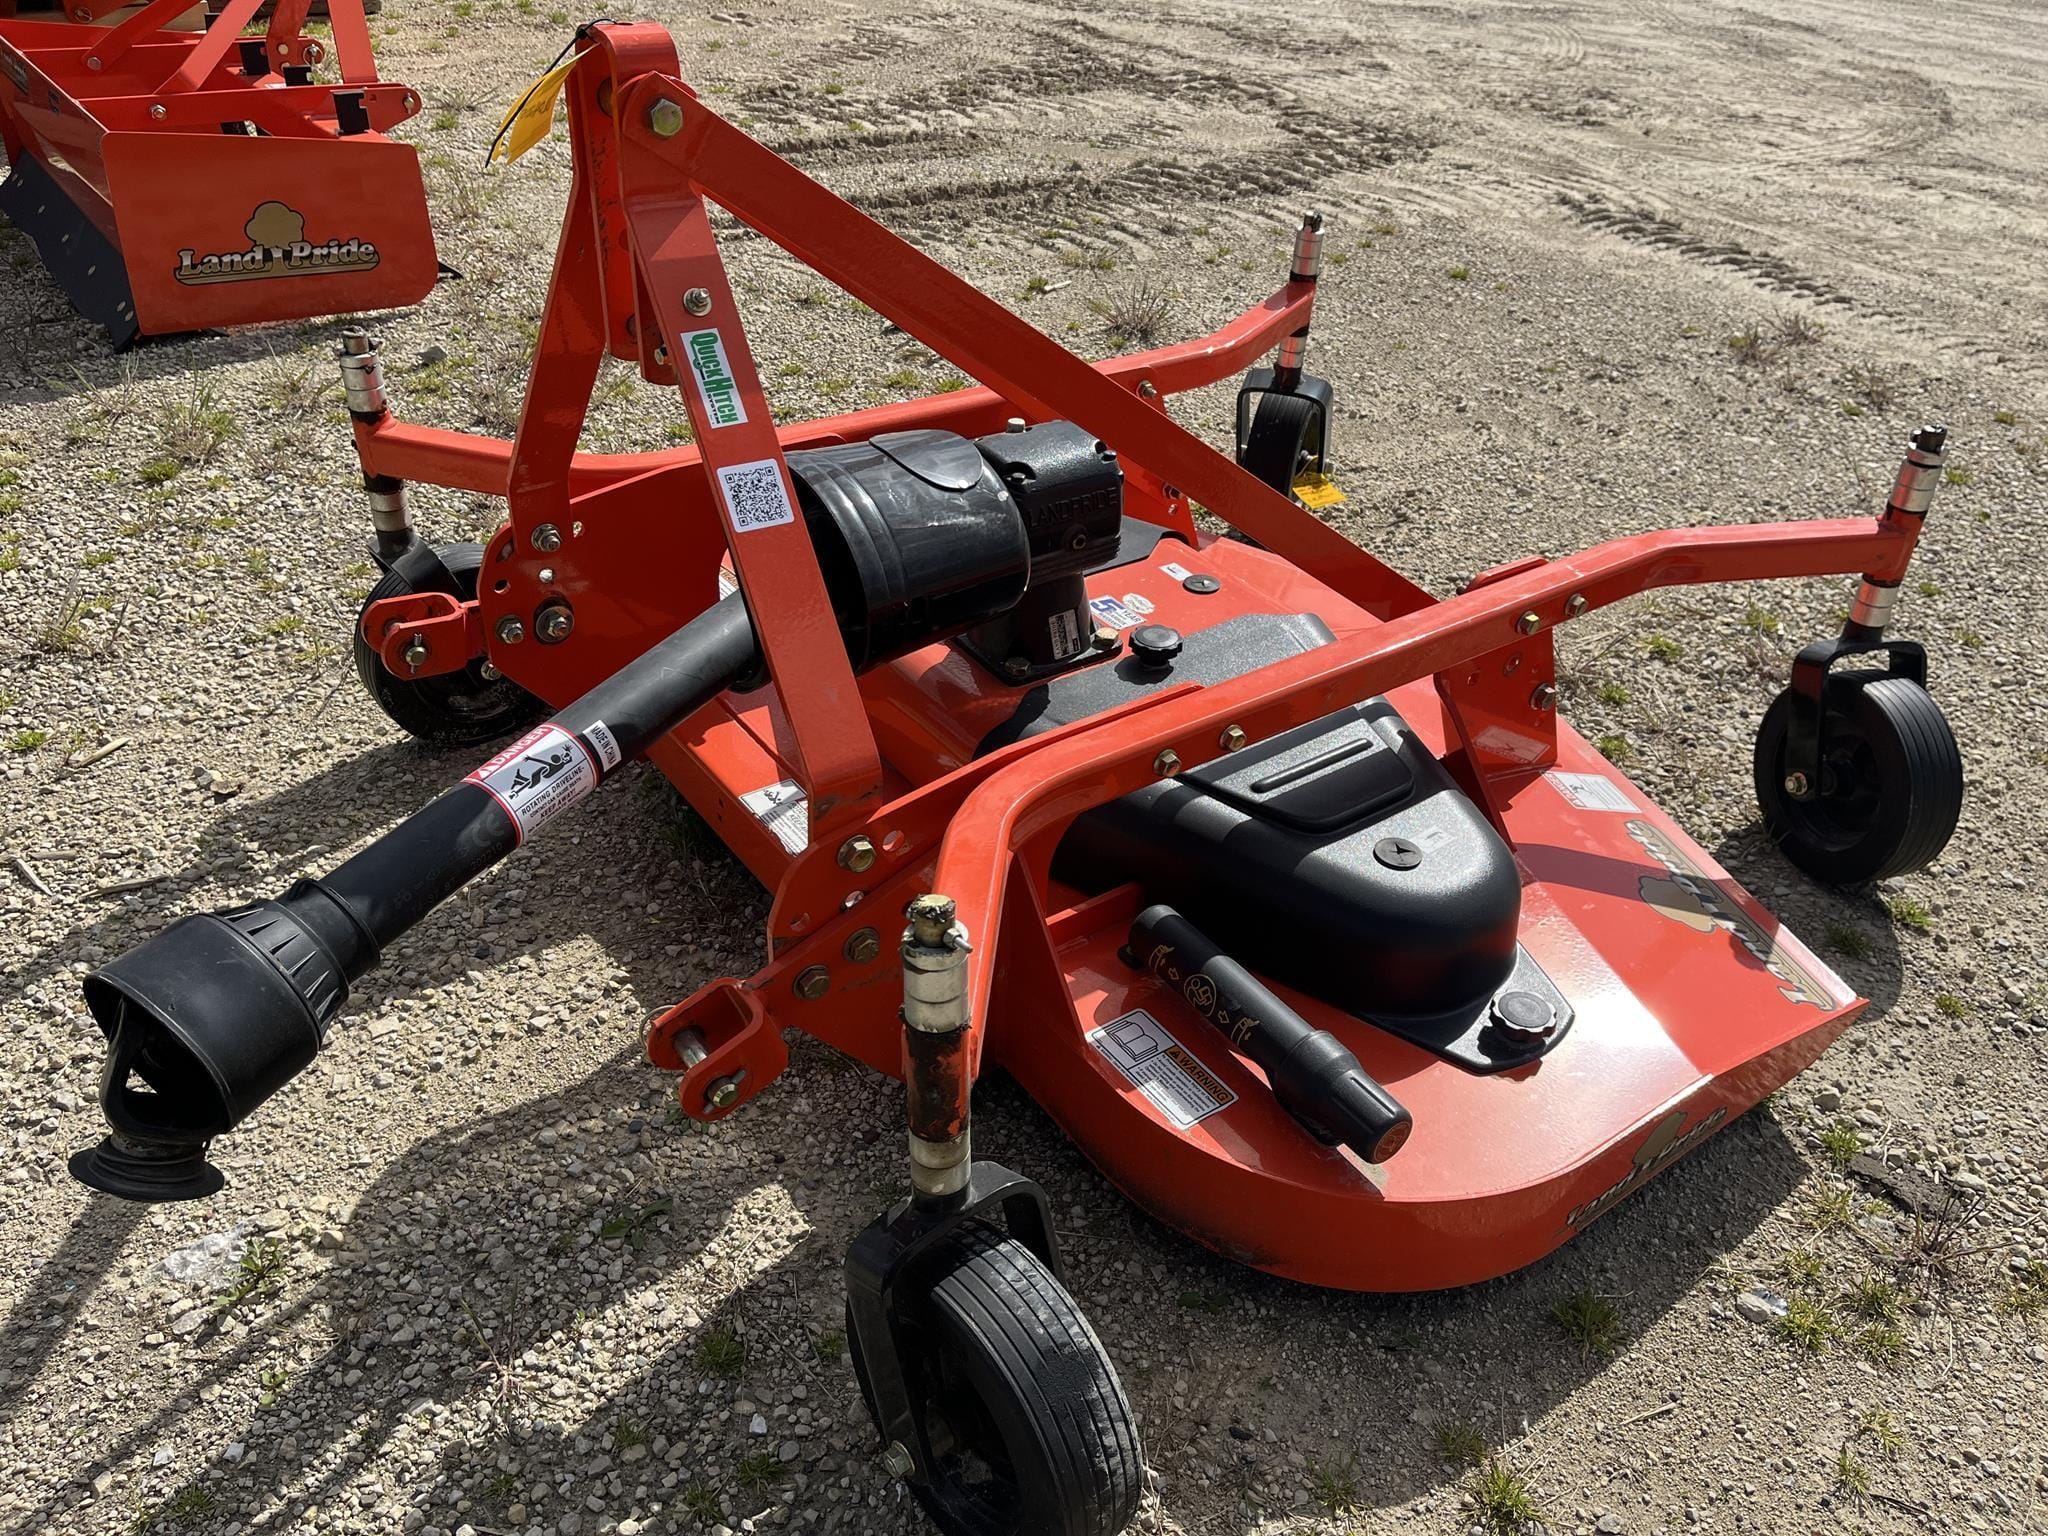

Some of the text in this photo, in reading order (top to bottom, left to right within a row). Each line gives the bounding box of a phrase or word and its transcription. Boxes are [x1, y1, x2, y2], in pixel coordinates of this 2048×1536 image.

[178, 238, 376, 276] Land Pride
[1090, 598, 1126, 612] 5
[591, 725, 608, 743] MADE
[495, 727, 548, 768] DANGER
[521, 790, 551, 816] ROTATING
[540, 802, 557, 818] KEEP
[1177, 1055, 1229, 1101] WARNING
